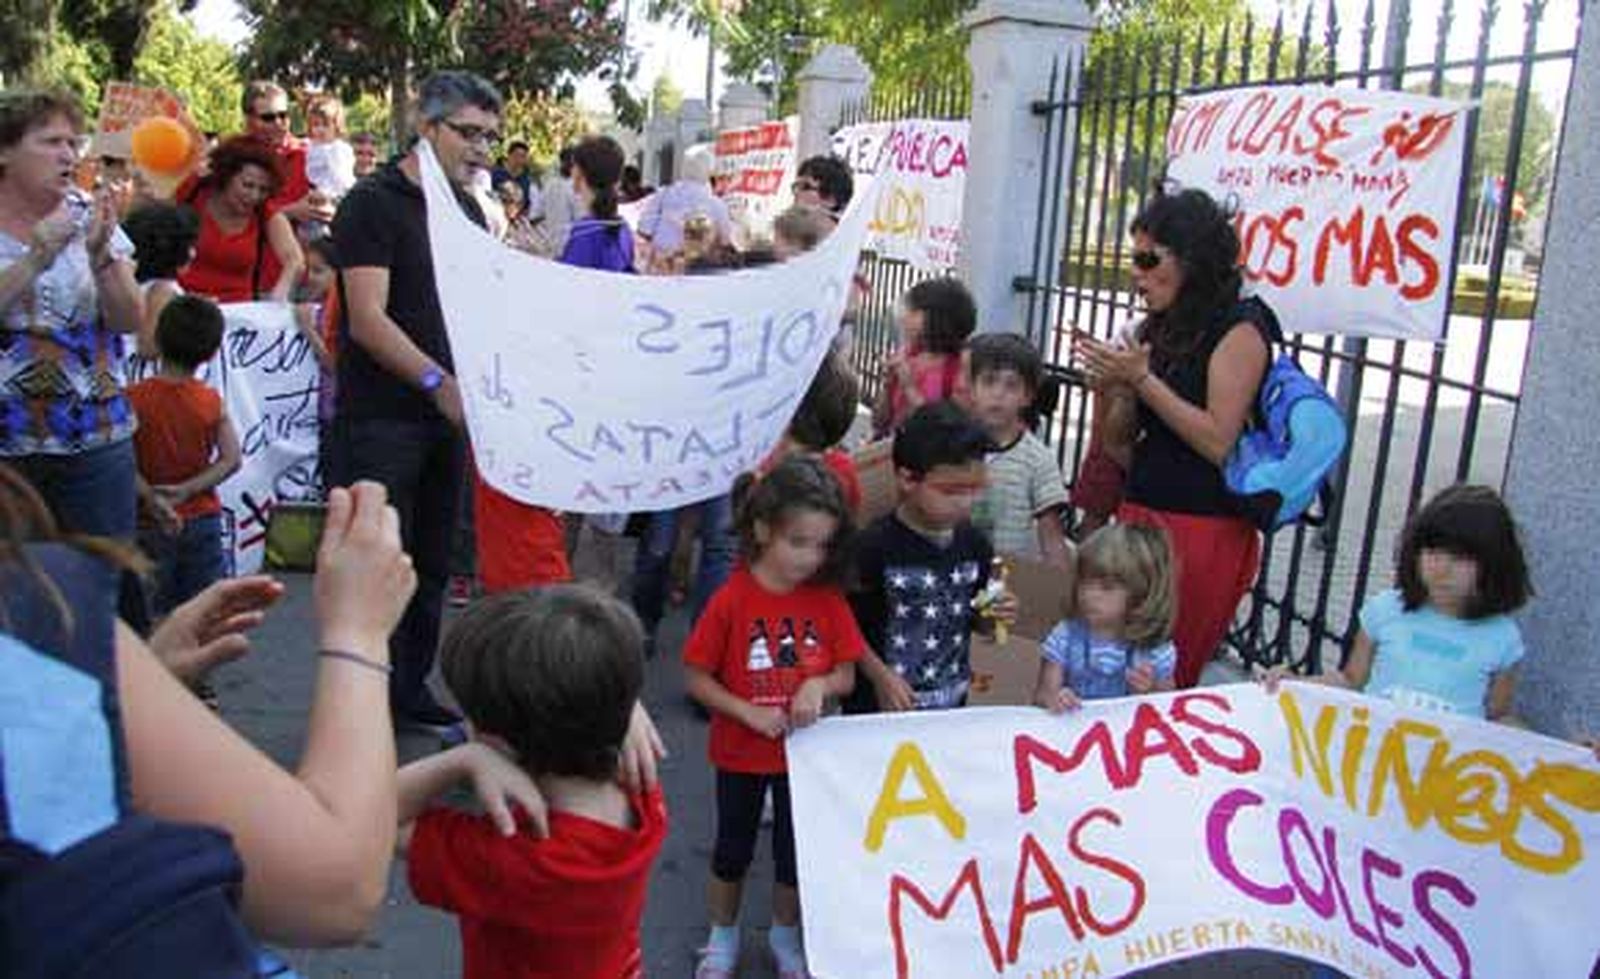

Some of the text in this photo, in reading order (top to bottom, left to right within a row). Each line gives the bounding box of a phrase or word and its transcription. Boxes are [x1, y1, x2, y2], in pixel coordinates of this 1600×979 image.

[1228, 92, 1369, 167] CLASE
[1236, 205, 1305, 287] OS
[863, 740, 966, 852] A
[1014, 694, 1261, 813] MAS
[888, 788, 1477, 979] MAS COLES
[1124, 919, 1255, 965] HUERTA
